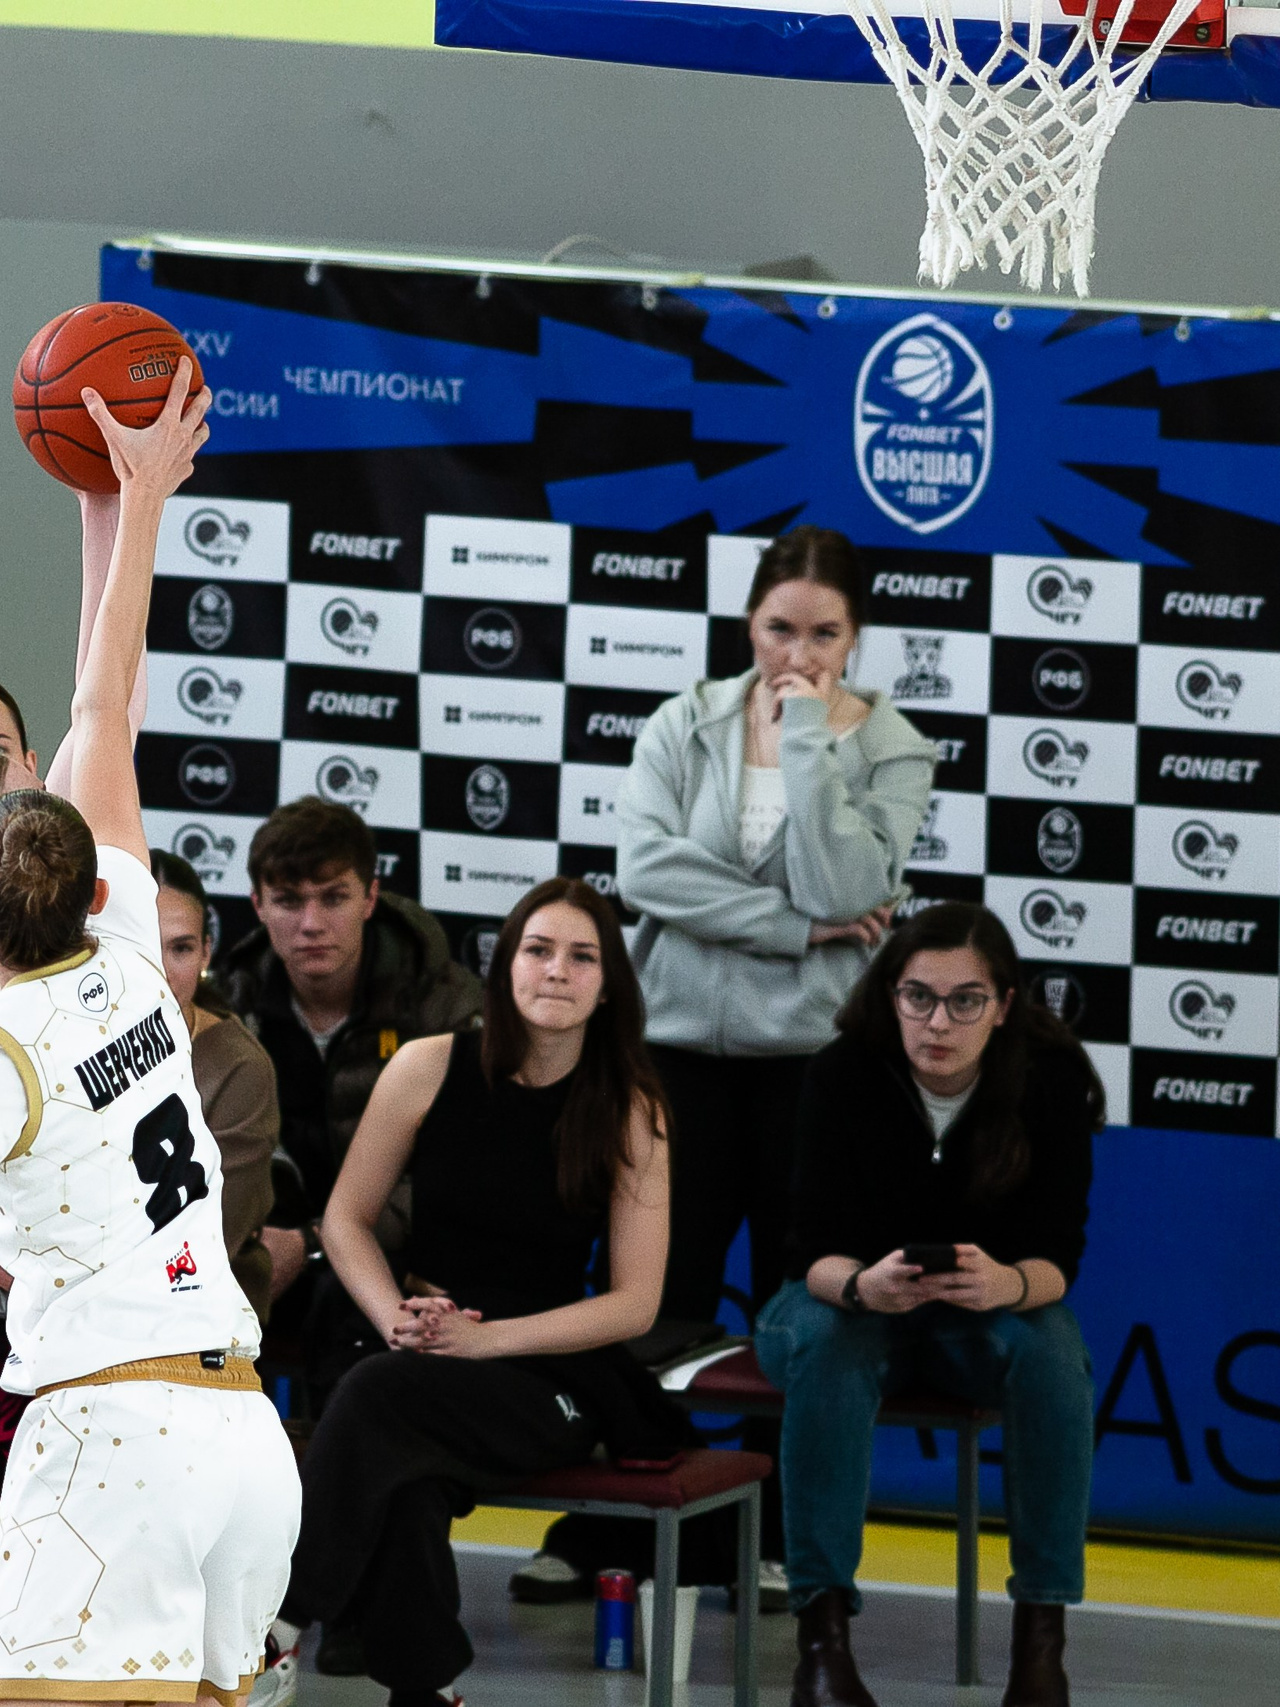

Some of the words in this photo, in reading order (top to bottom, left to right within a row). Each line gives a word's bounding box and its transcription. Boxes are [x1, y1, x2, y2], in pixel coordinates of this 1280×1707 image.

[282, 366, 465, 404] ЧЕМПИОНАТ
[207, 388, 280, 418] СИИ
[886, 423, 963, 444] FONBET
[872, 448, 973, 486] ВЫСШАЯ
[309, 531, 402, 560] FONBET
[591, 552, 686, 580] FONBET
[872, 572, 970, 600] FONBET
[1162, 591, 1264, 619] FONBET
[307, 690, 399, 719] FONBET
[1159, 754, 1260, 783] FONBET
[1156, 915, 1257, 944] FONBET
[82, 983, 104, 1004] РФБ
[74, 1007, 176, 1112] ШЕВЧЕНКО
[1153, 1077, 1254, 1106] FONBET
[132, 1093, 209, 1235] 8
[165, 1241, 197, 1285] NRJ
